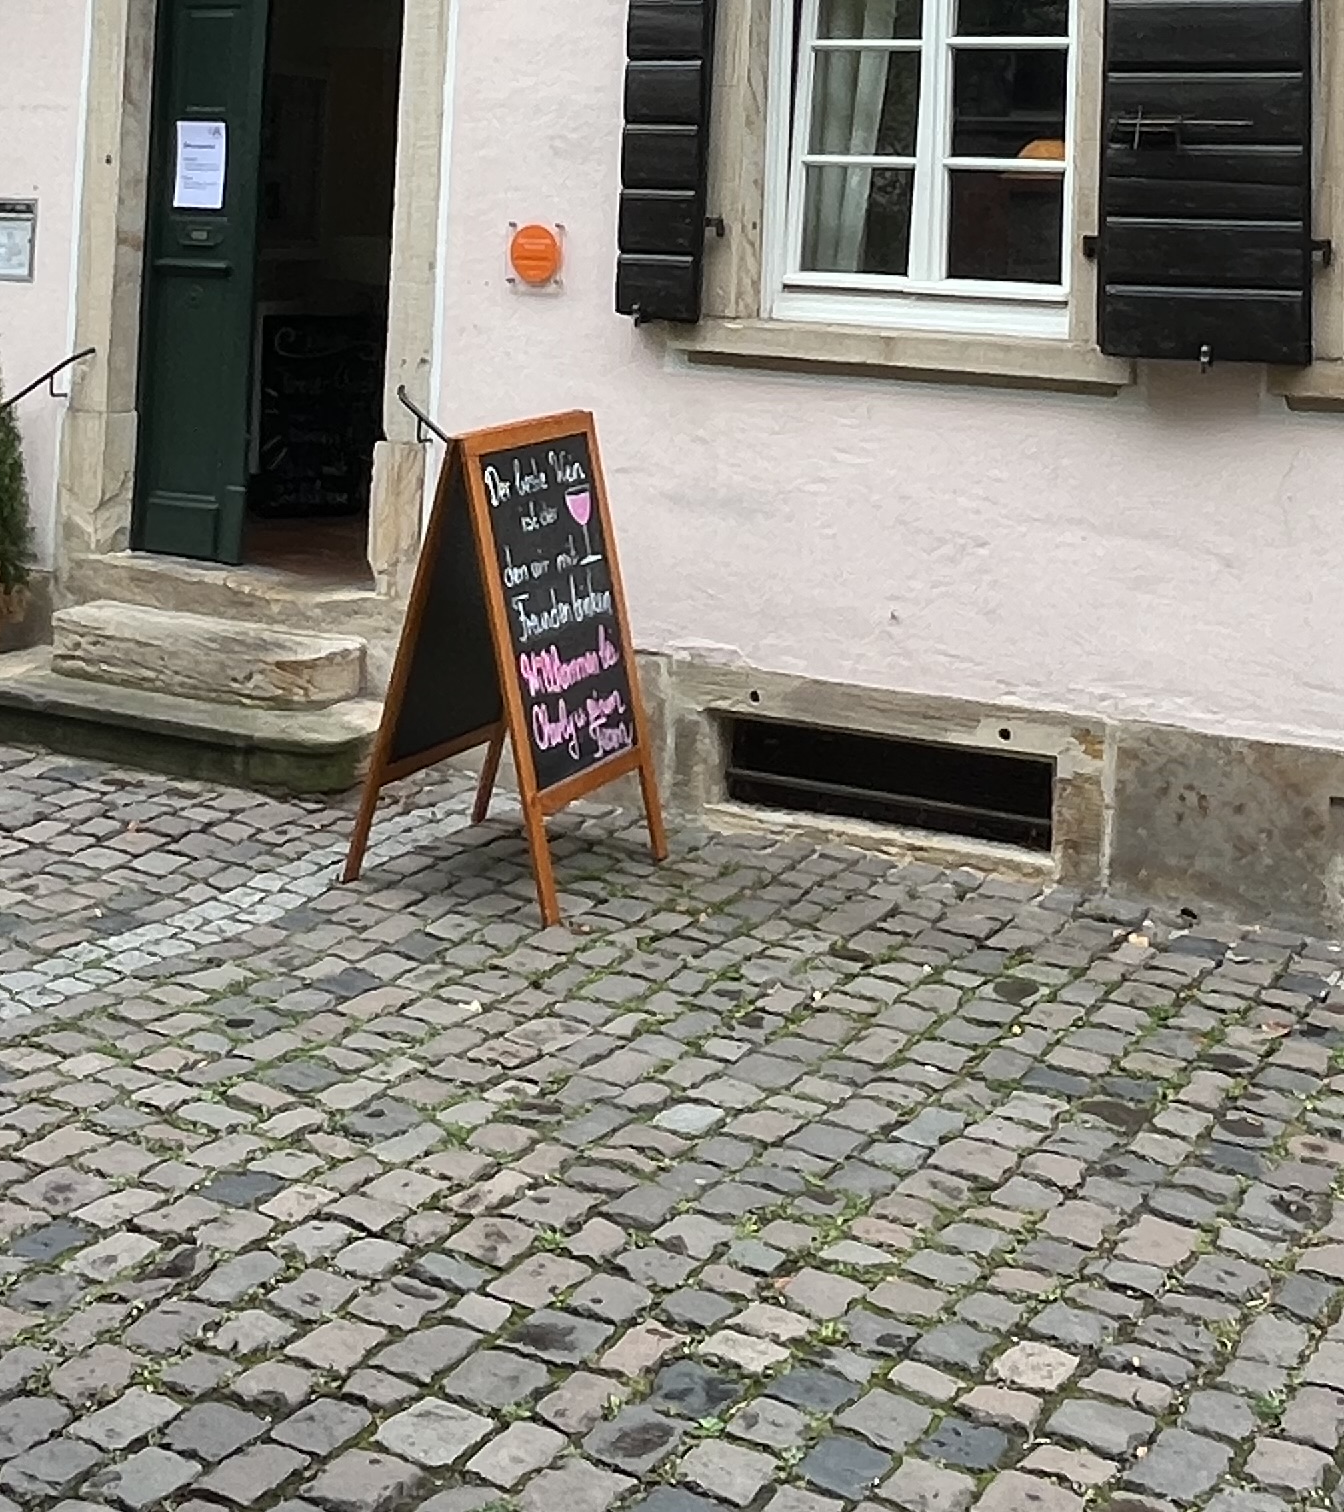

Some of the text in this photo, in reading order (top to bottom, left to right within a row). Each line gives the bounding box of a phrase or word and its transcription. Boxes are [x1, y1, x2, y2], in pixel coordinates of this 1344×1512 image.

[484, 466, 511, 507] Der
[548, 450, 586, 483] Wein
[518, 500, 540, 532] ist
[502, 534, 579, 588] den wir mit
